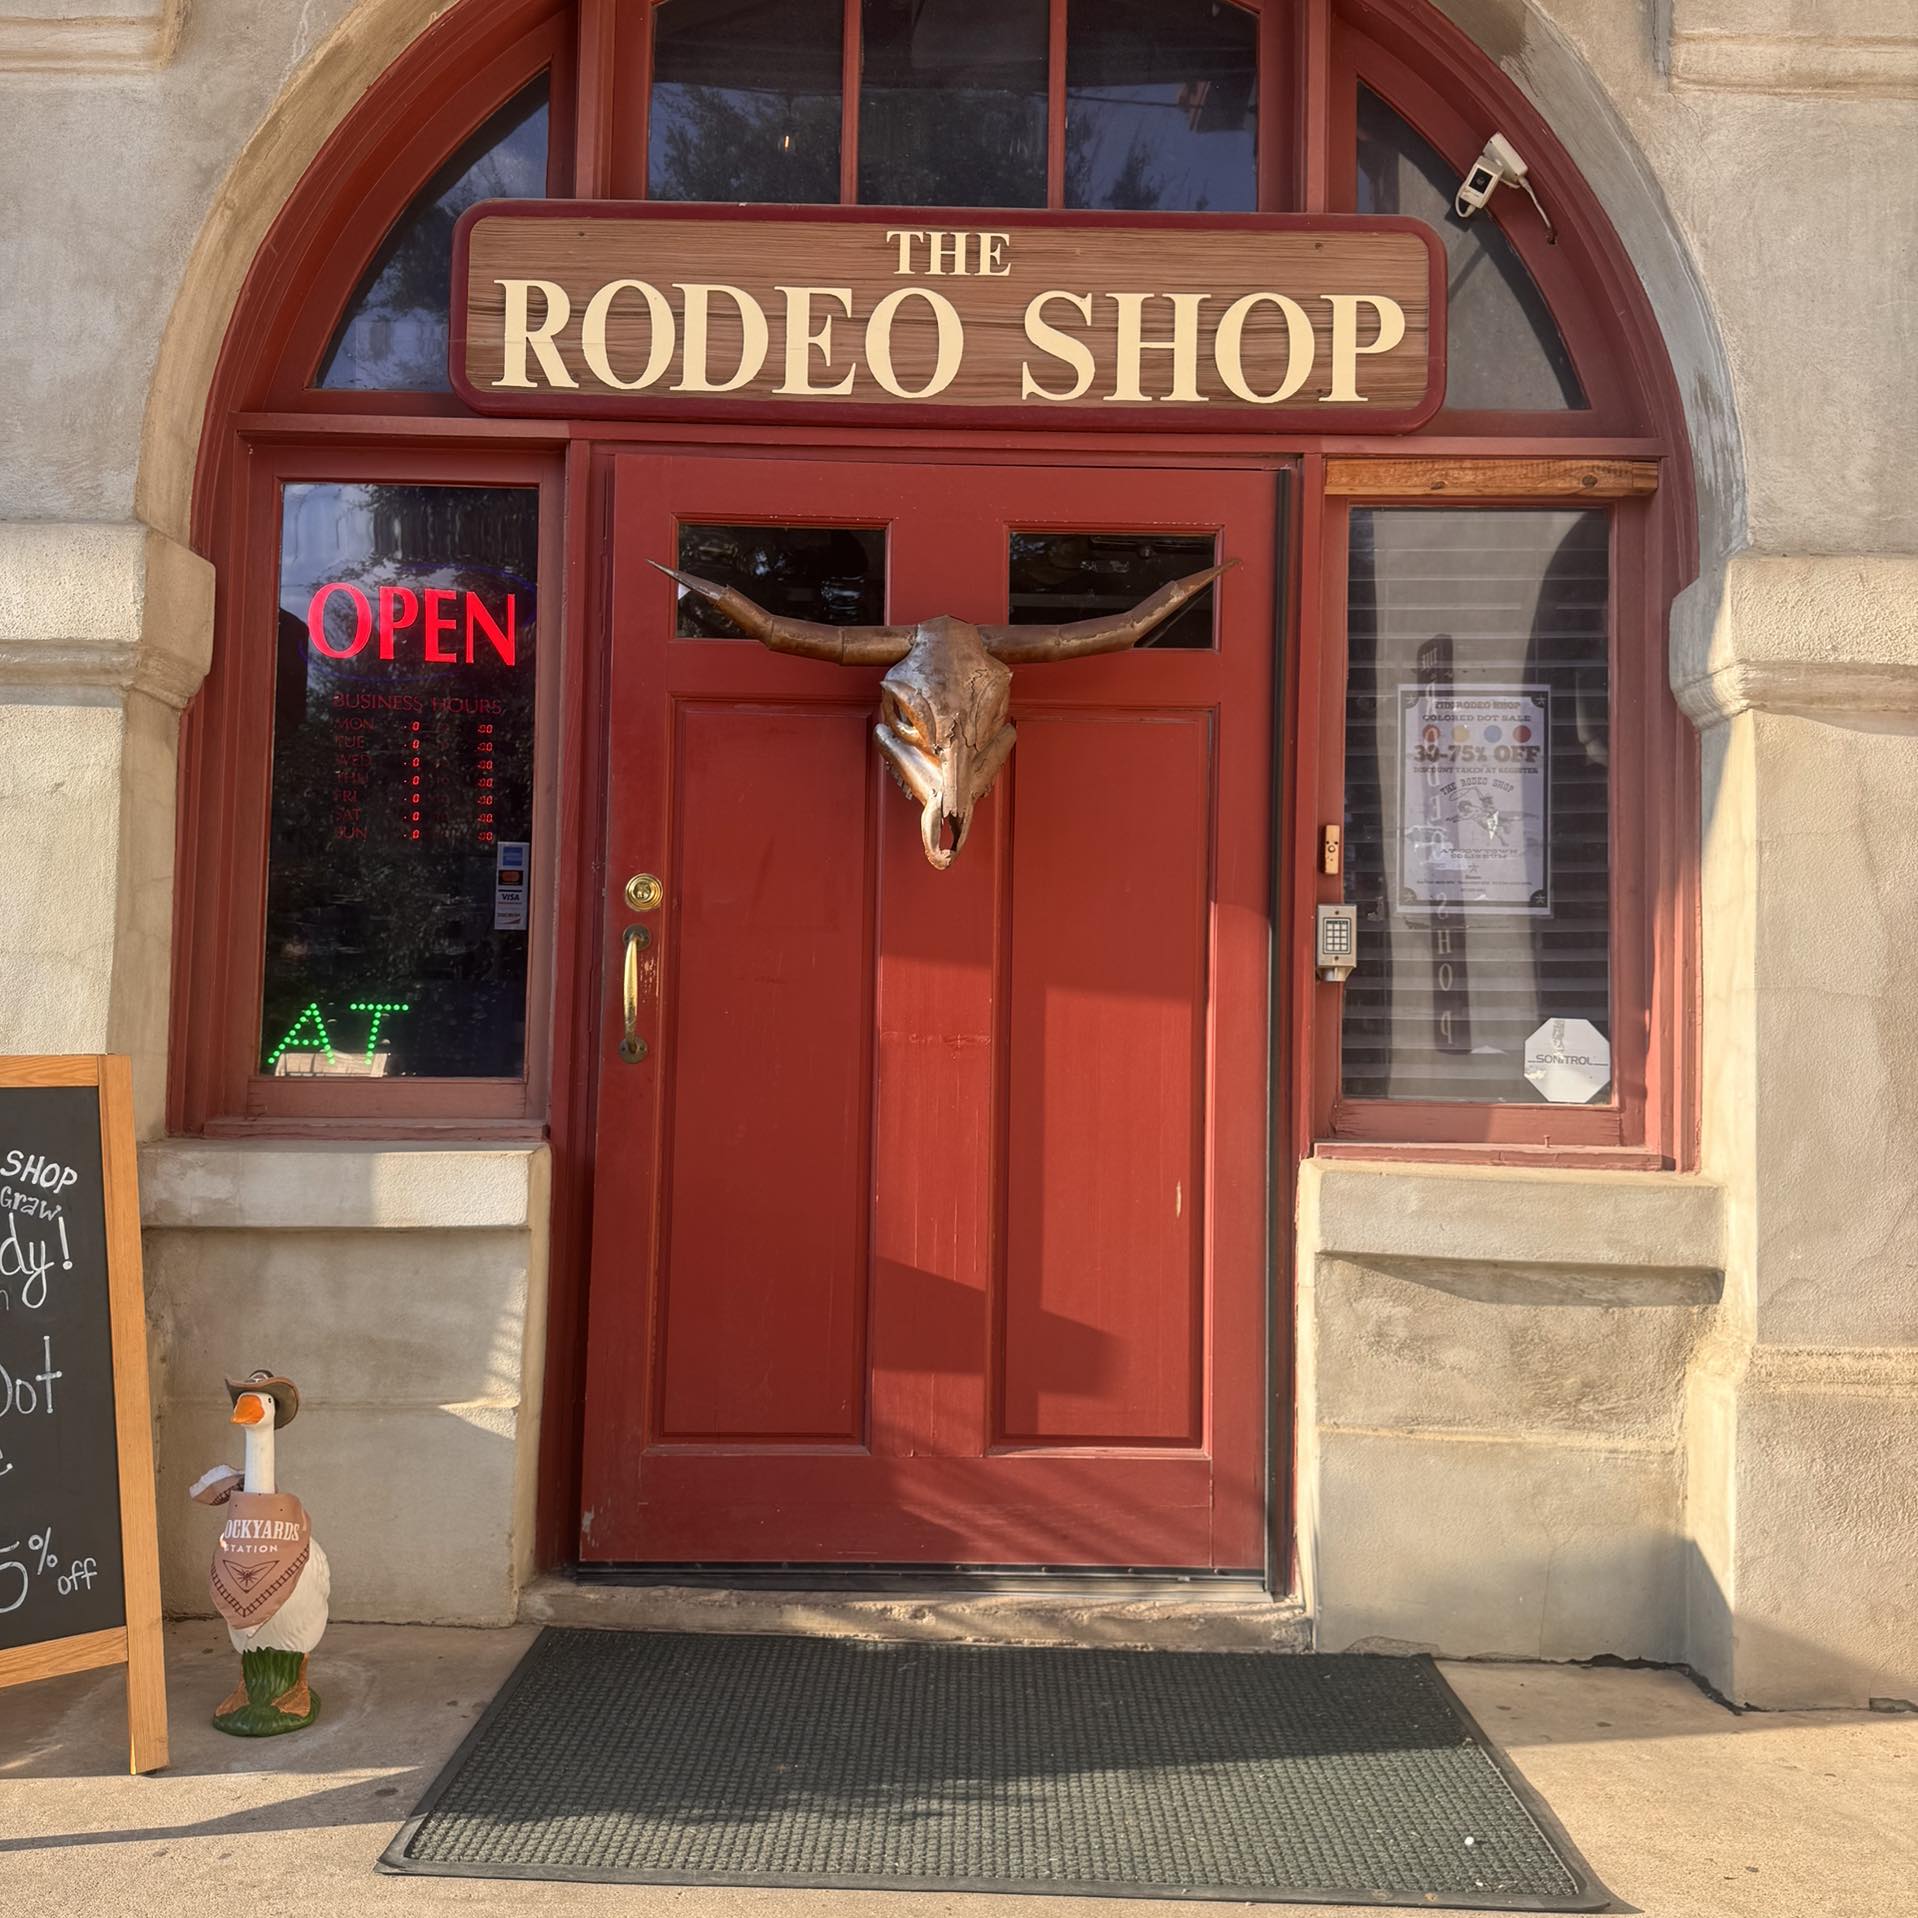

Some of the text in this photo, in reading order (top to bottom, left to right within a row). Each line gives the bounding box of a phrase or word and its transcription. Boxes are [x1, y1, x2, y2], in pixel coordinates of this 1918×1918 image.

[886, 231, 1012, 277] THE
[491, 278, 1406, 403] RODEO SHOP
[308, 582, 516, 666] OPEN
[332, 694, 503, 715] BUSINESS HOURS
[335, 717, 375, 731] MON
[1422, 714, 1531, 722] COLORED DOT SALE
[1493, 744, 1541, 763] OFF
[1439, 782, 1457, 796] THE
[1460, 776, 1488, 787] RODEO
[502, 893, 520, 901] VISA
[1535, 1054, 1593, 1066] SONITROL
[0, 1150, 79, 1194] SHOP
[224, 1519, 301, 1541] OCKYARDS
[57, 1557, 98, 1595] off
